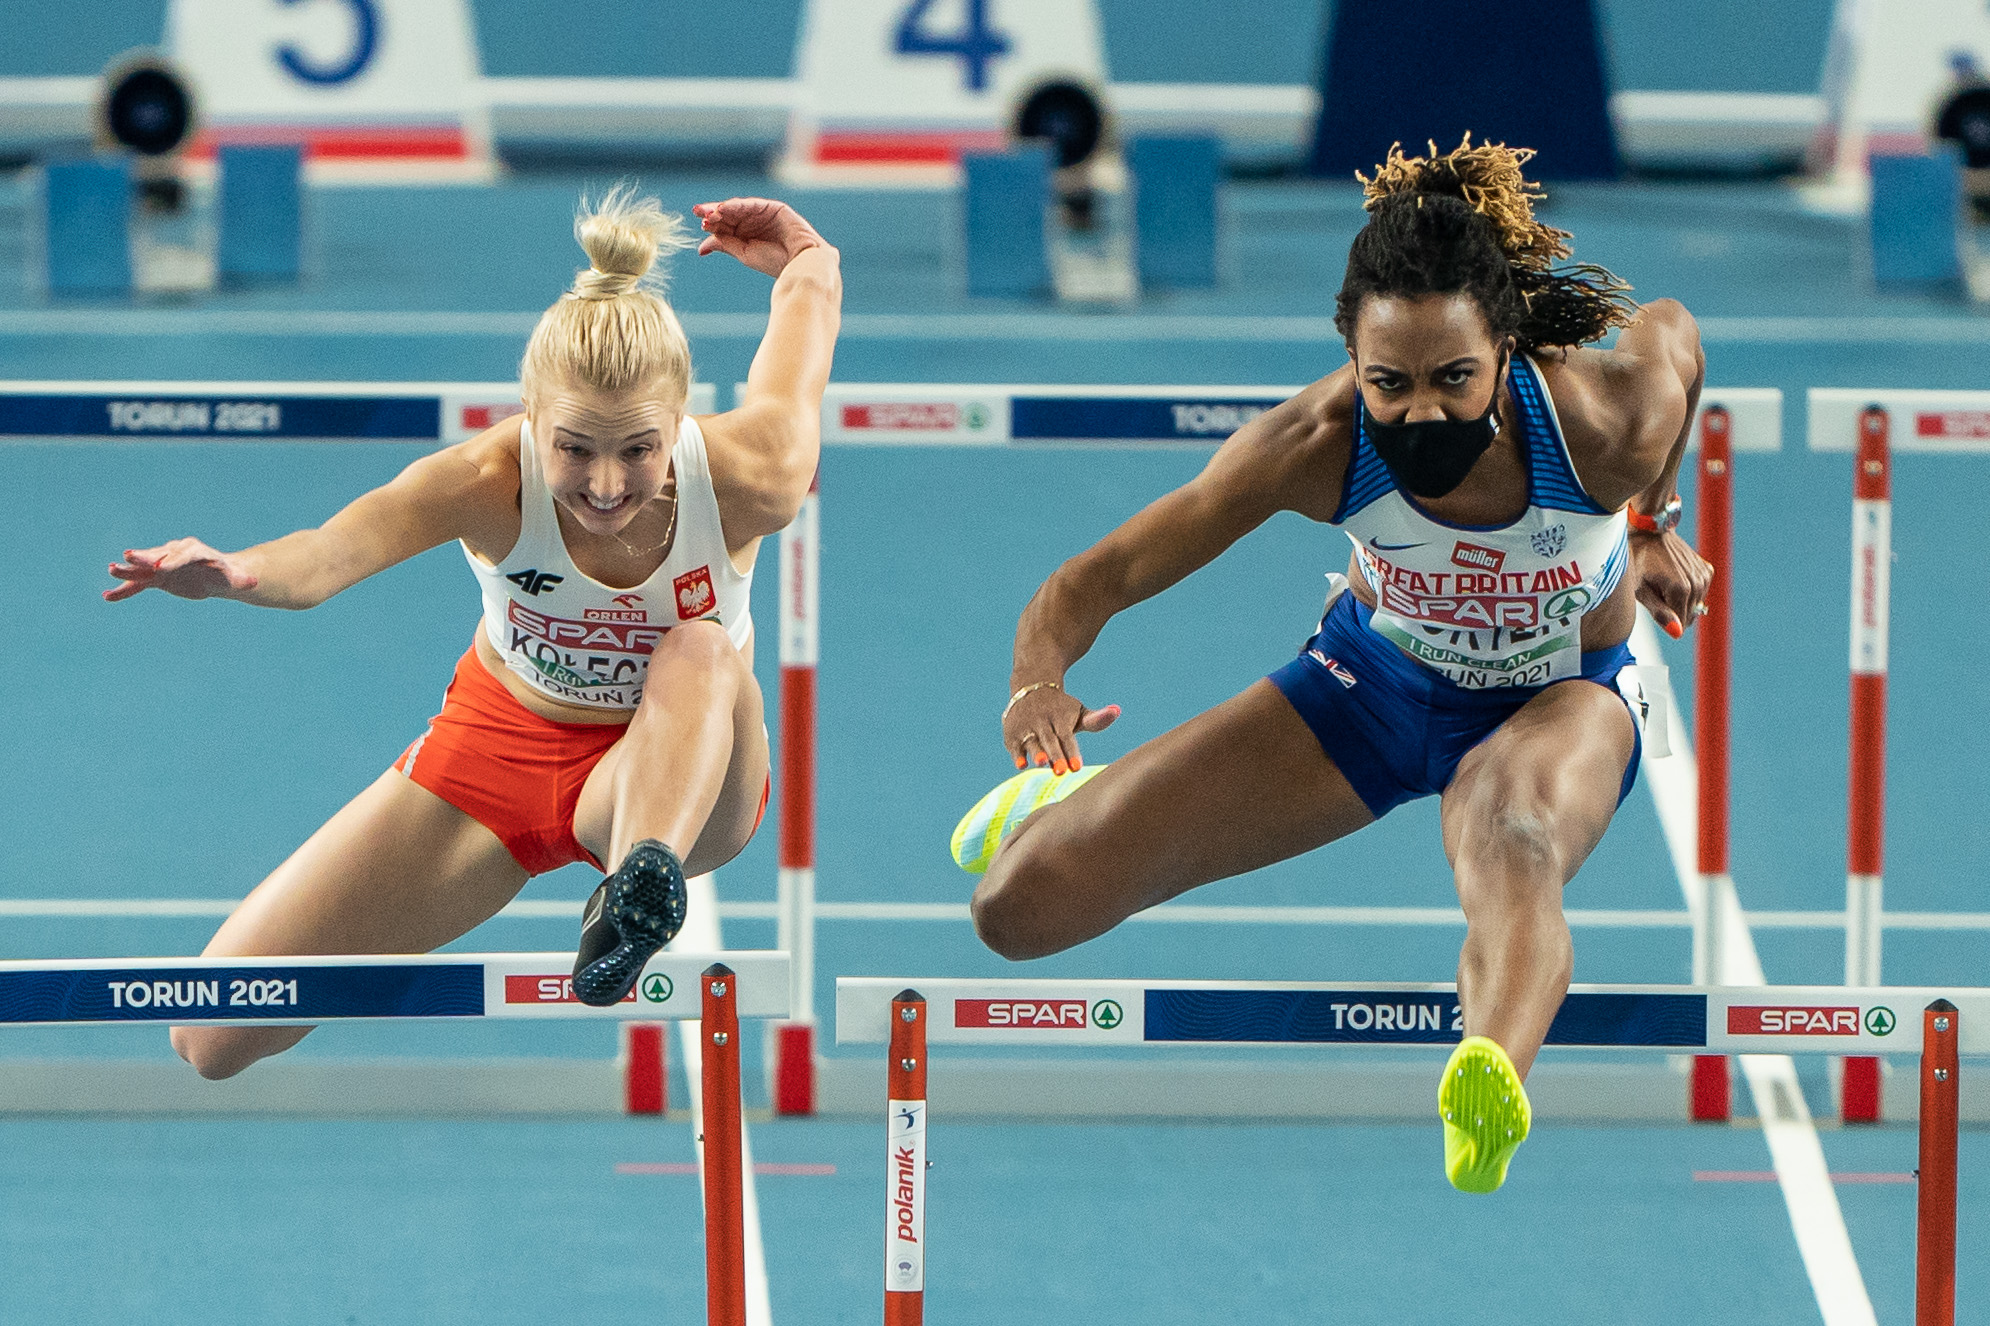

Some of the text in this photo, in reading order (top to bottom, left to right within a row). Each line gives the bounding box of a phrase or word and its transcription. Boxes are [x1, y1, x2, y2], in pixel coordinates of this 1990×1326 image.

[895, 0, 1010, 91] 4
[1456, 548, 1499, 568] müller
[506, 569, 564, 596] 4F
[675, 569, 707, 585] POLSKA
[1456, 560, 1582, 594] BRITAIN
[587, 611, 644, 621] ORLEN
[1386, 586, 1534, 627] SPAR
[1409, 639, 1532, 671] I RUN CLEAN
[108, 979, 297, 1008] TORUN 2021
[987, 1003, 1084, 1025] SPAR
[1330, 1003, 1440, 1031] TORUN
[1760, 1010, 1857, 1032] SPAR
[894, 1145, 918, 1243] polanik
